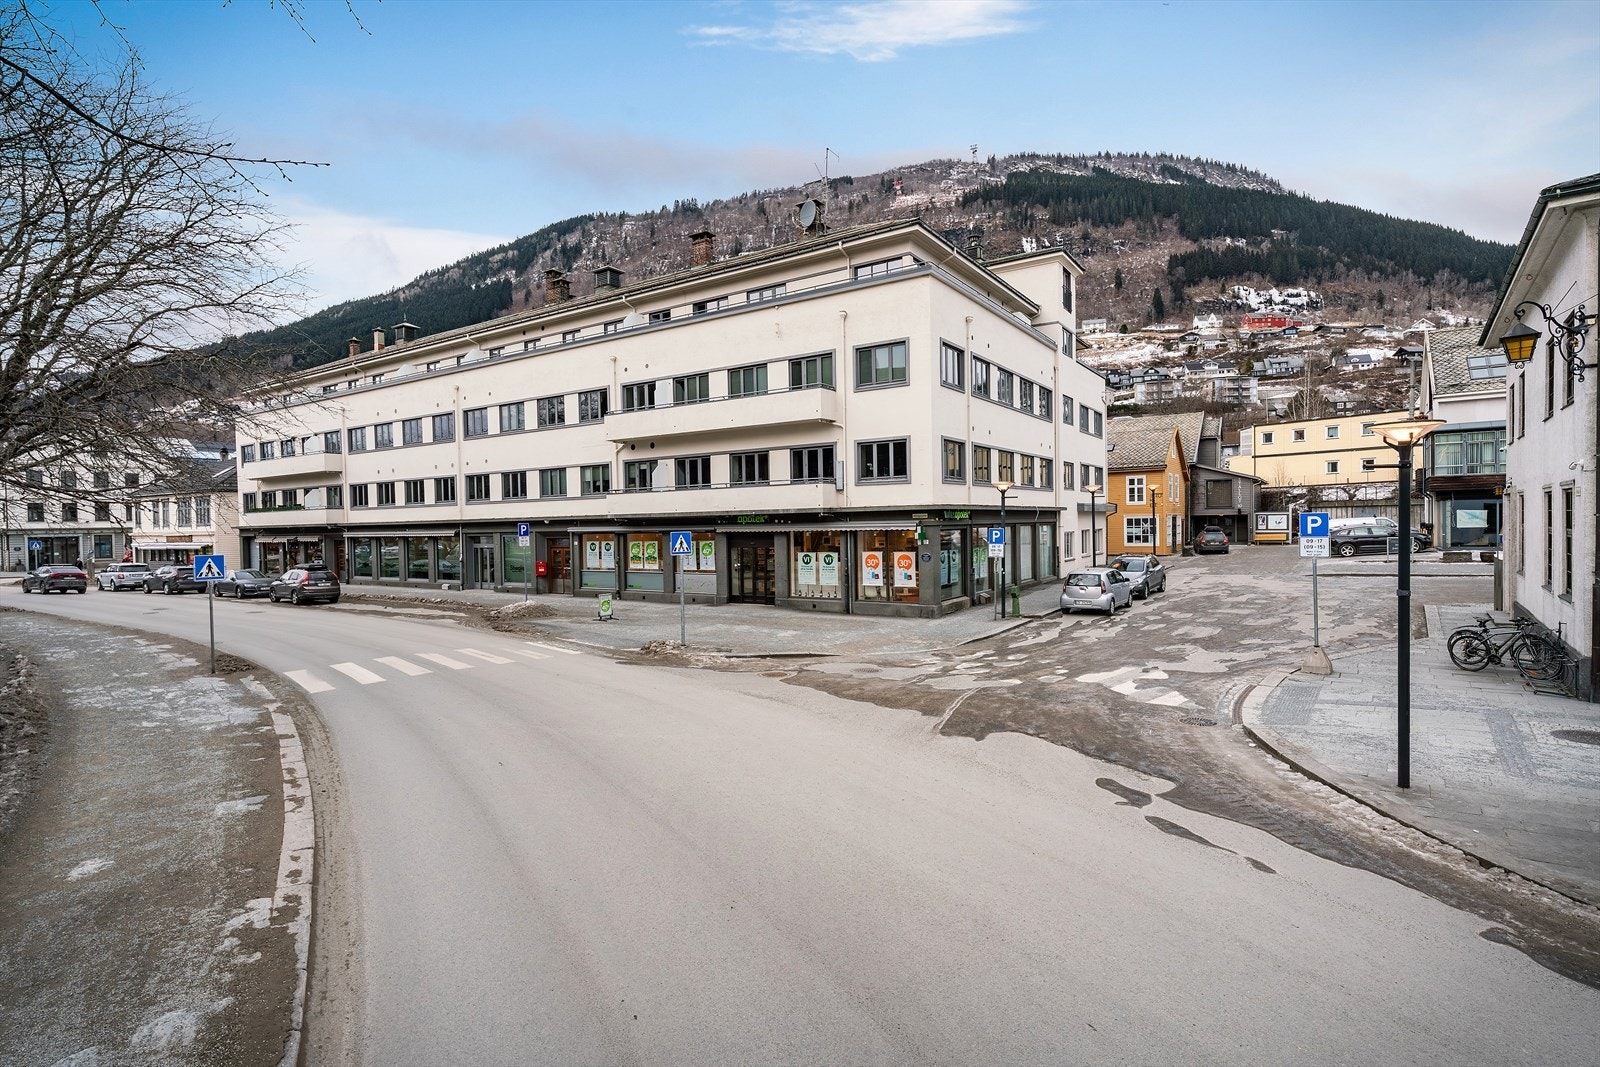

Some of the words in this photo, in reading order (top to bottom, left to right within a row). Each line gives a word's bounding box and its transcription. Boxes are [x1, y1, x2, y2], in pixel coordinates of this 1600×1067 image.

[521, 525, 527, 535] P
[1307, 516, 1322, 534] P
[992, 531, 1000, 542] P
